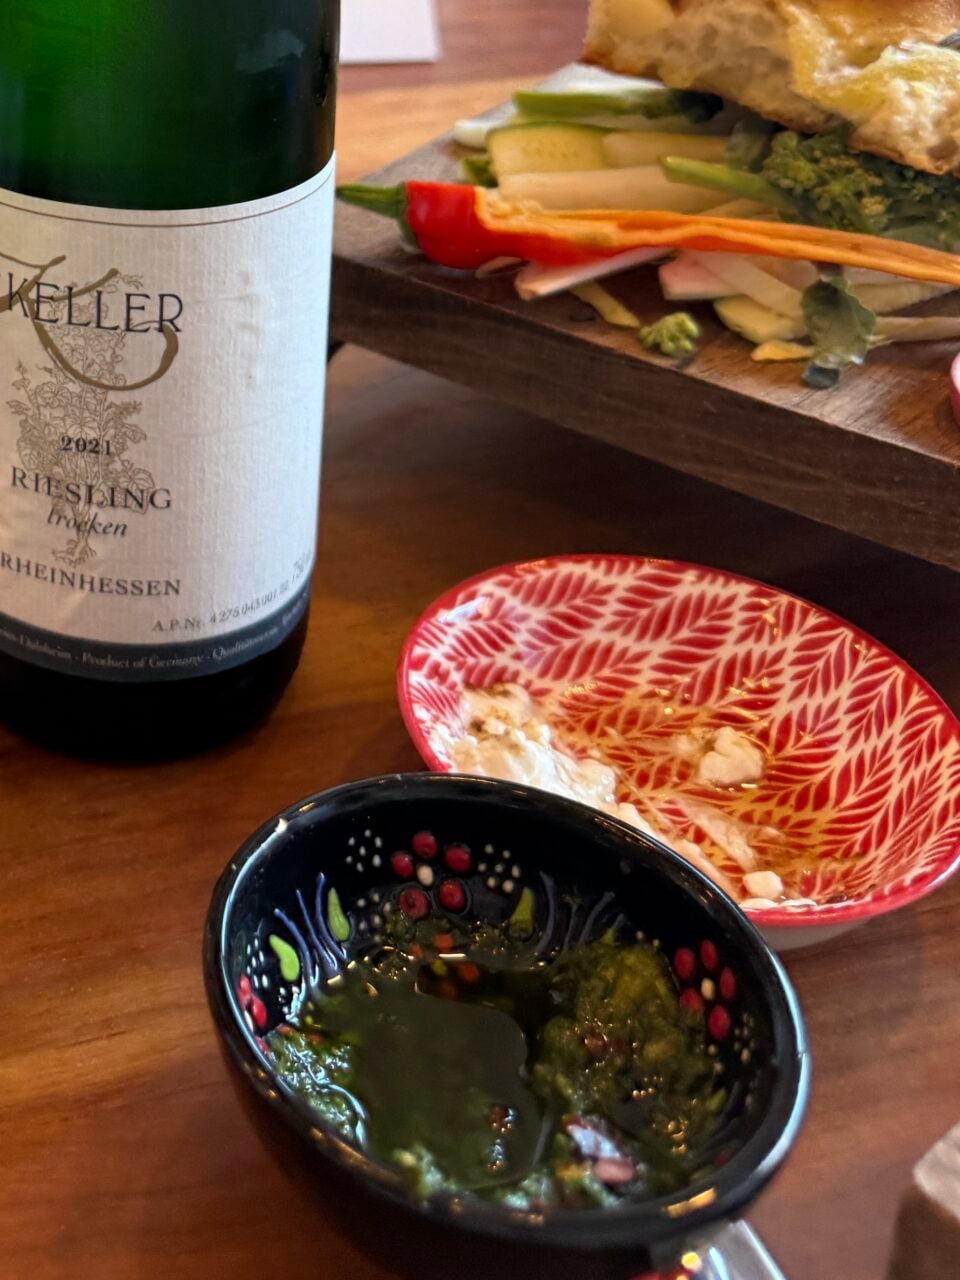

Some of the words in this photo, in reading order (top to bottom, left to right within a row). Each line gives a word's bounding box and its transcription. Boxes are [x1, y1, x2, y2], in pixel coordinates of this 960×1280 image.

[7, 271, 184, 333] KELLER
[60, 435, 113, 457] 2021
[10, 465, 173, 511] RIESLING
[45, 506, 128, 538] trocken
[0, 552, 182, 597] RHEINHESSEN
